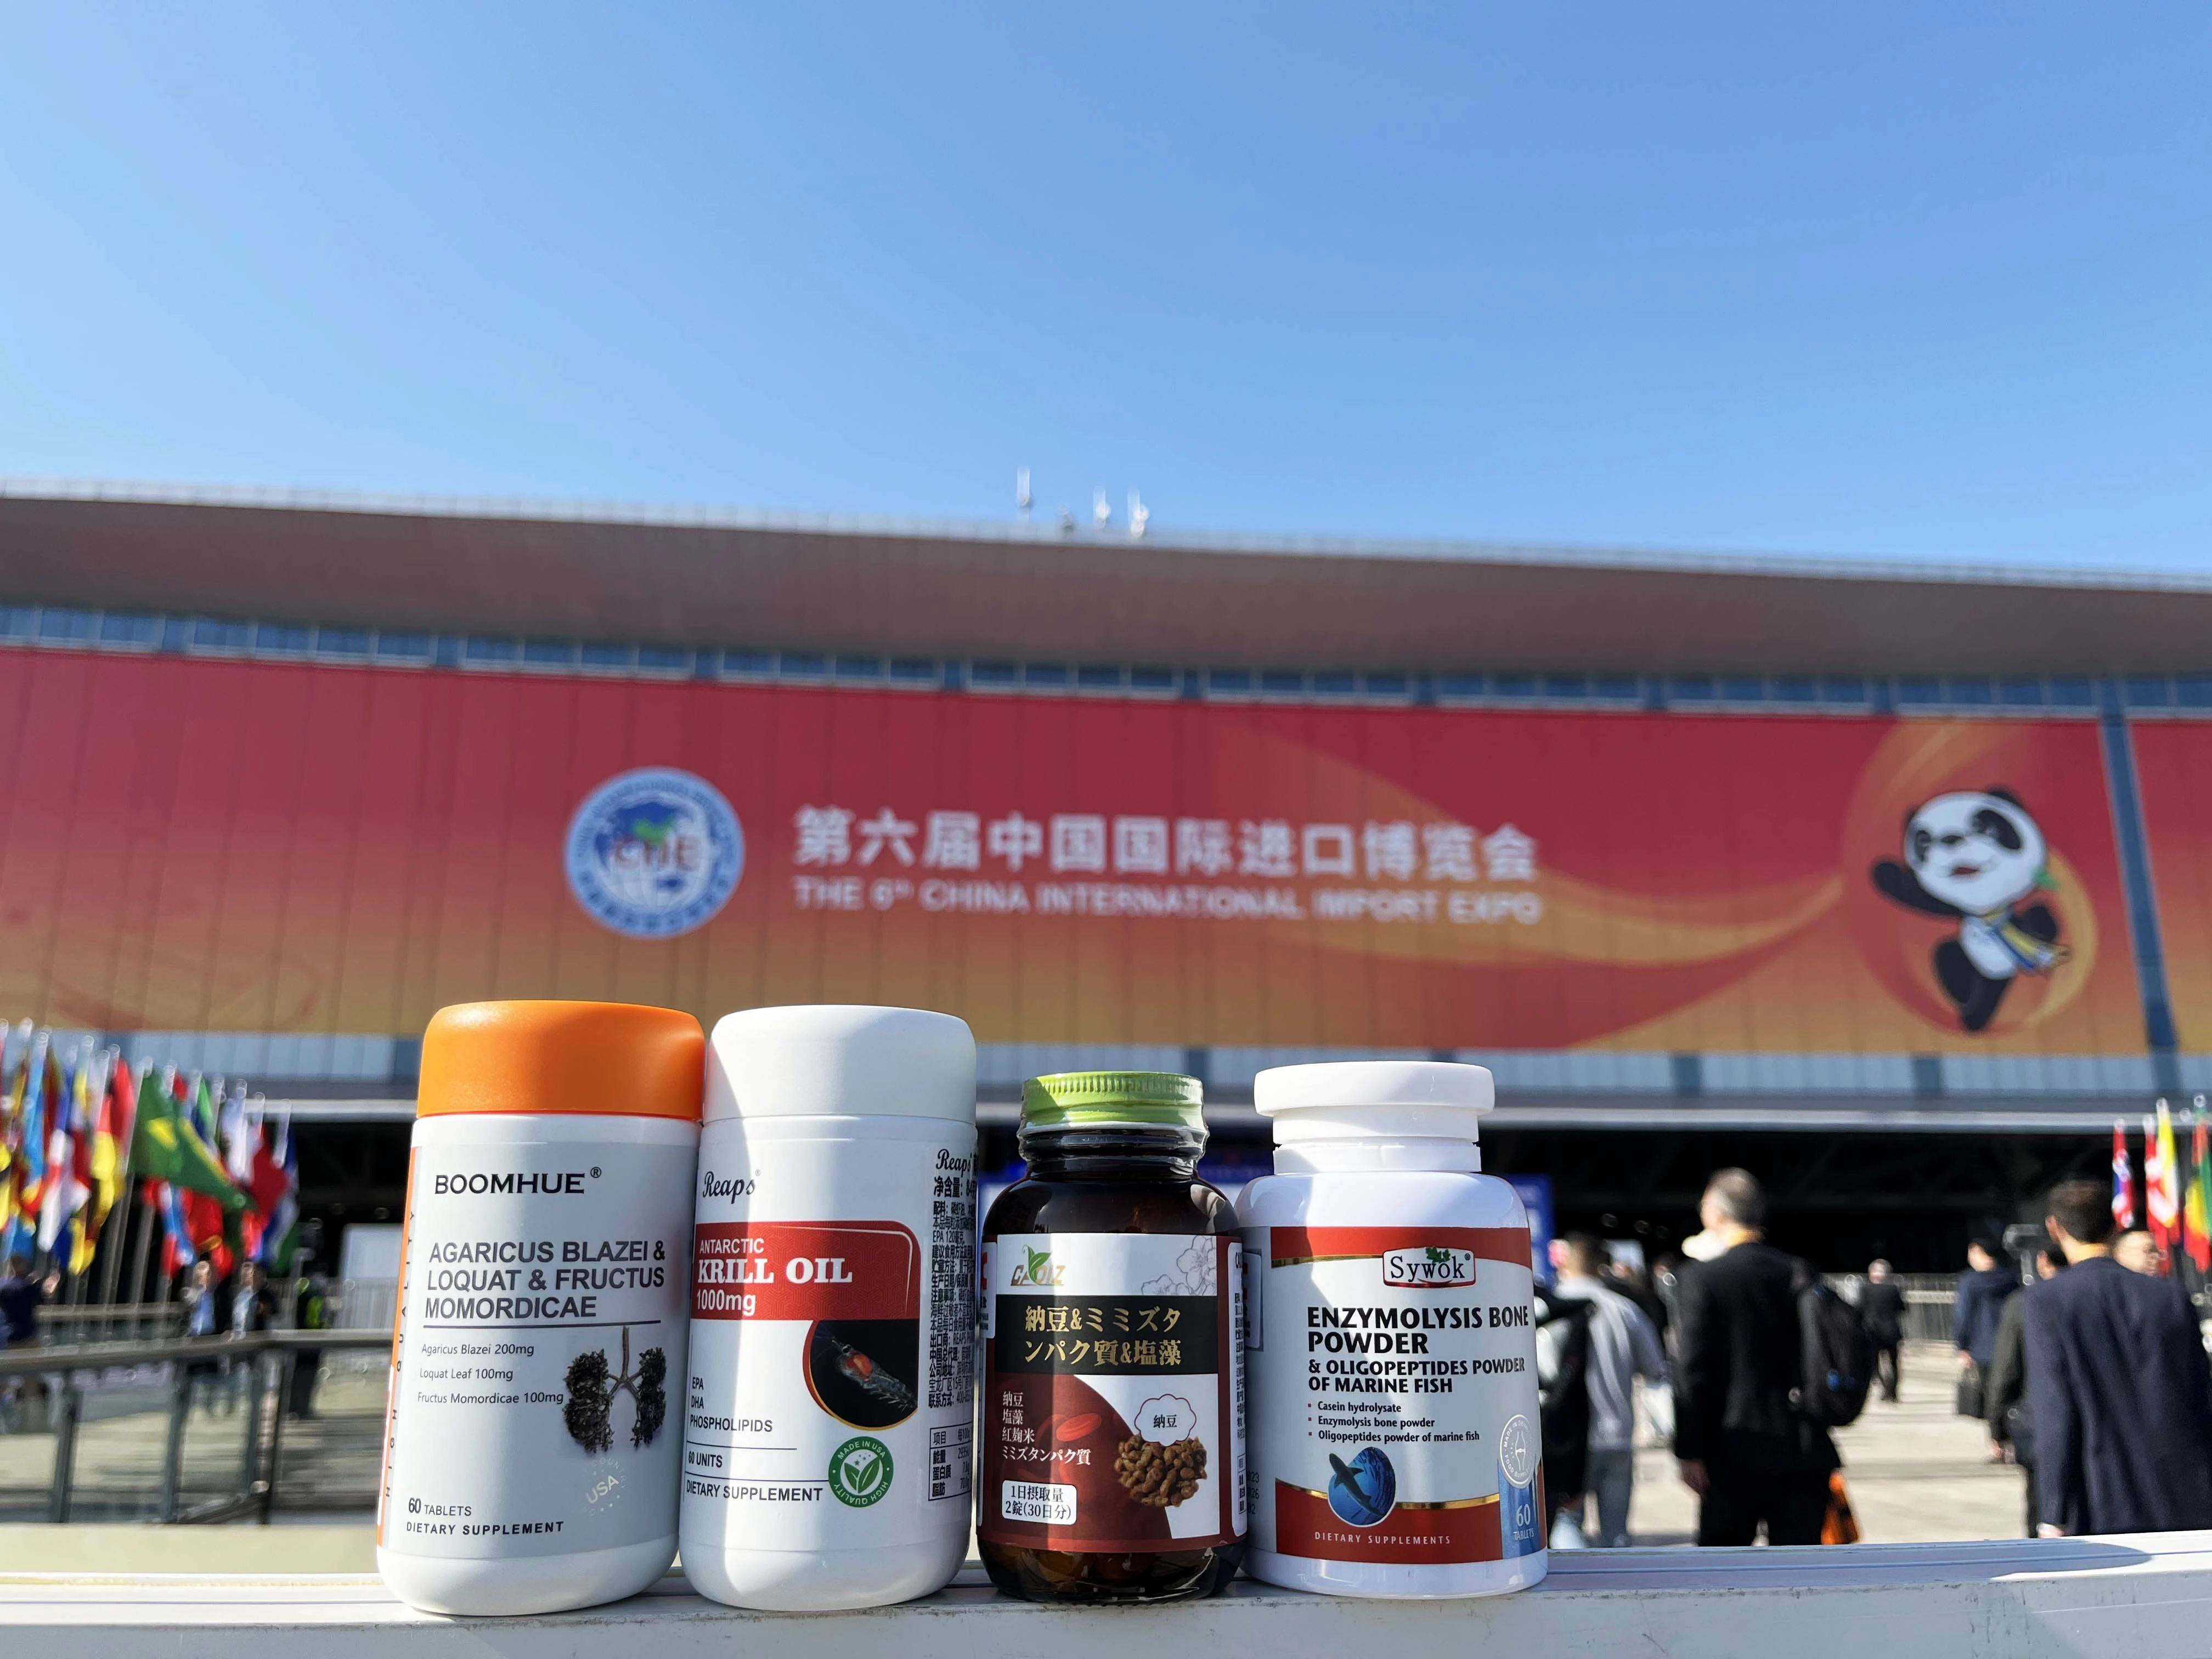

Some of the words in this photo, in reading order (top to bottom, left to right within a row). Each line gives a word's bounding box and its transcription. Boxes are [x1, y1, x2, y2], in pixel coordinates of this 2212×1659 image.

[794, 805, 1537, 880] 第六届中国国际进口博览会
[793, 878, 864, 910] THE
[919, 880, 1028, 912] CHINA
[1037, 882, 1307, 920] INTERNATIONAL
[1312, 888, 1440, 922] IMPORT
[1447, 890, 1543, 926] EXPO
[429, 1241, 555, 1263] AGARICUS
[562, 1240, 648, 1262] BLAZEI
[653, 1240, 666, 1261] &
[699, 1238, 765, 1255] ANTARCTIC
[697, 1257, 774, 1284] KRILL
[786, 1256, 853, 1284] OIL
[427, 1269, 522, 1293] LOQUAT
[528, 1269, 547, 1291] &
[555, 1267, 665, 1290] FRUCTUS
[425, 1296, 597, 1319] MOMORDICAE
[696, 1288, 757, 1316] 1000mg
[1307, 1306, 1482, 1329] ENZYMOLYSIS
[1489, 1305, 1530, 1328] BONE
[421, 1344, 458, 1357] Agaricus
[461, 1344, 491, 1355] Blazei
[494, 1344, 534, 1357] 200mg
[1308, 1331, 1429, 1354] POWDER
[420, 1367, 449, 1380] Loquat
[451, 1368, 472, 1379] Leaf
[475, 1368, 514, 1382] 100mg
[1308, 1359, 1321, 1374] &
[1326, 1359, 1468, 1376] OLIGOPEPTIDES
[1472, 1357, 1526, 1374] POWDER
[692, 1376, 704, 1391] EPA
[1308, 1376, 1330, 1391] OF
[1335, 1377, 1409, 1392] MARINE
[1414, 1378, 1452, 1393] FISH
[417, 1392, 448, 1403] Fructus
[450, 1392, 520, 1404] Momordicae
[523, 1392, 564, 1405] 100mg
[691, 1396, 704, 1410] DHA
[1002, 1390, 1024, 1408] 納豆
[1317, 1401, 1346, 1412] Casein
[1347, 1402, 1402, 1414] hydrolysate
[690, 1413, 773, 1433] PHOSPHOLIPIDS
[1002, 1408, 1024, 1426] 塩藻
[1153, 1414, 1178, 1429] 納豆
[1318, 1415, 1372, 1428] Enzymolysis
[1374, 1417, 1398, 1427] bone
[1400, 1417, 1436, 1430] powder
[1318, 1430, 1382, 1443] Oligopeptides
[1384, 1432, 1420, 1444] powder
[1421, 1431, 1432, 1442] of
[1434, 1431, 1464, 1442] marine
[1465, 1430, 1480, 1441] fish
[837, 1441, 860, 1460] MADE
[862, 1440, 871, 1448] IN
[871, 1442, 886, 1458] USA
[1001, 1444, 1091, 1466] ミミズタンパク質
[688, 1451, 695, 1464] 60
[696, 1453, 723, 1469] UNITS
[585, 1474, 620, 1504] USA
[686, 1479, 721, 1499] DIETARY
[723, 1485, 824, 1502] SUPPLEMENT
[833, 1483, 868, 1505] QUALITY
[870, 1481, 889, 1502] HIGH
[408, 1497, 422, 1514] 60
[424, 1504, 472, 1516] TABLETS
[1515, 1504, 1531, 1526] 60
[406, 1521, 456, 1535] DIETARY
[462, 1521, 564, 1536] SUPPLEMENT
[1314, 1531, 1361, 1543] DIETARY
[1368, 1534, 1451, 1545] SUPPLEMENTS
[1513, 1529, 1535, 1542] TABLETS
